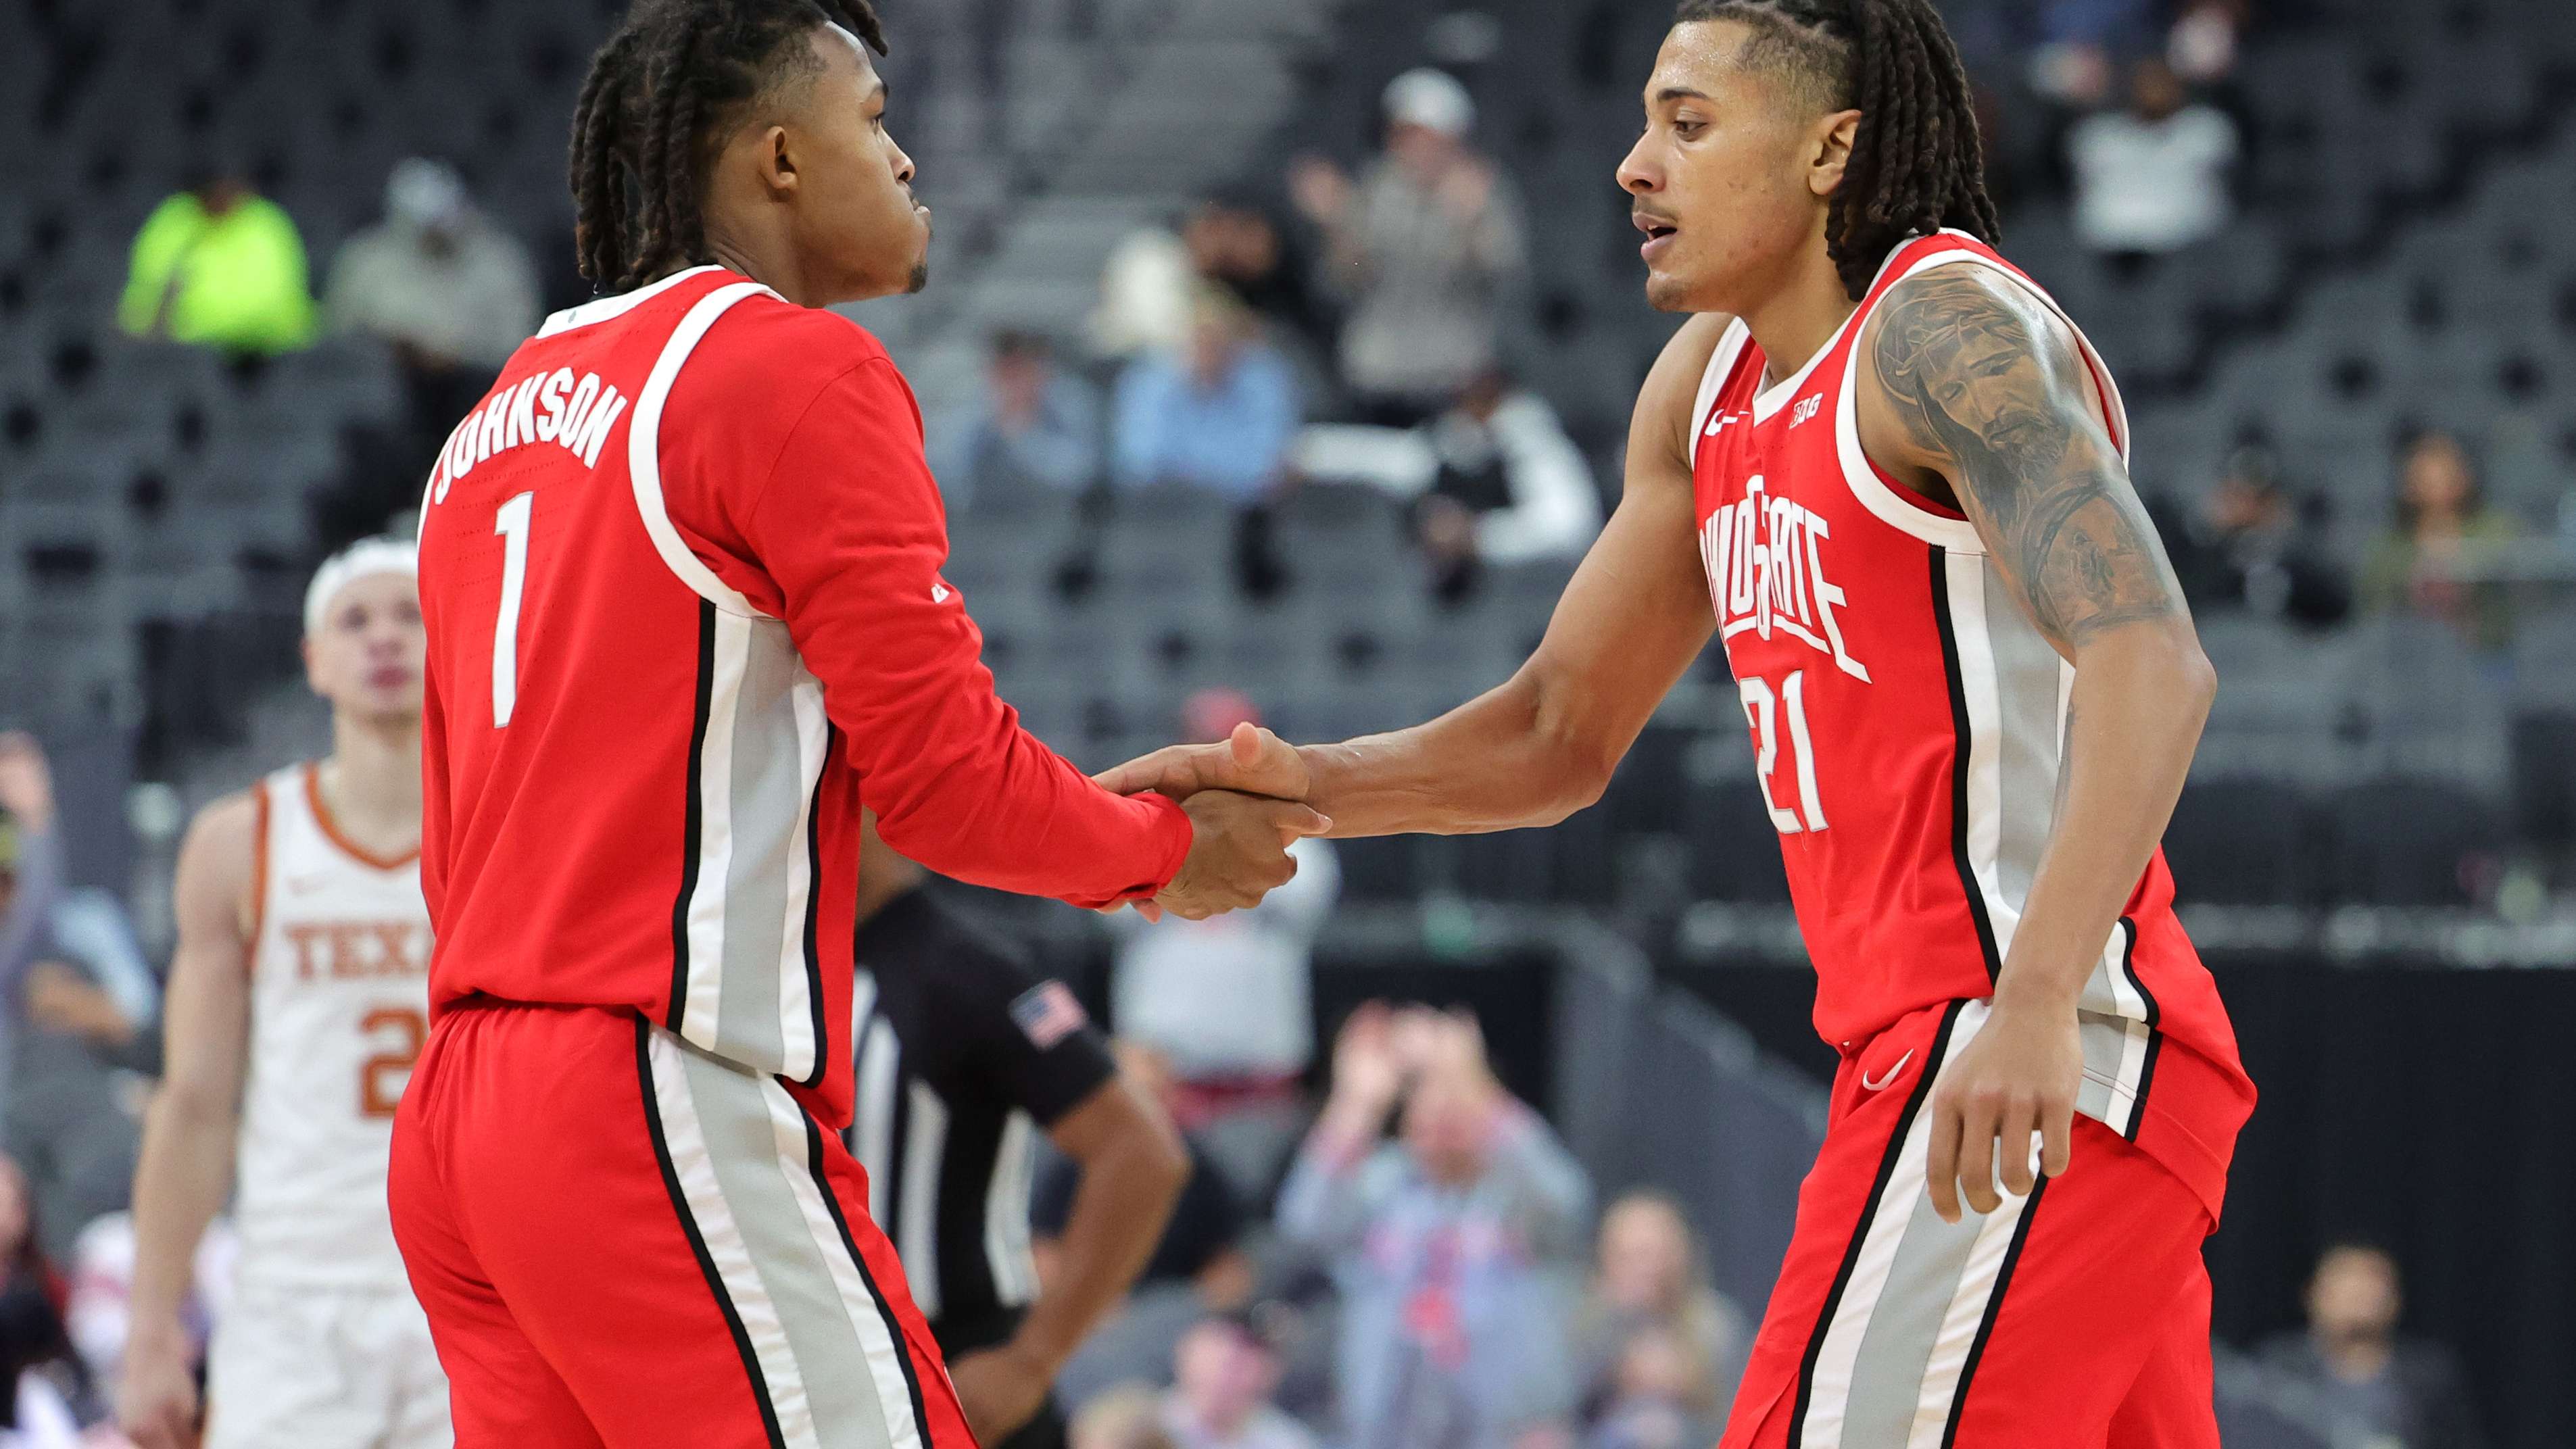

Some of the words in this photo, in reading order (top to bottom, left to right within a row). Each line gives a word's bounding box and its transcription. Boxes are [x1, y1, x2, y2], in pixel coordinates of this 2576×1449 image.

[434, 366, 628, 506] JOHNSON
[491, 491, 534, 729] 1
[1740, 670, 1829, 833] 21
[360, 1008, 433, 1118] 2
